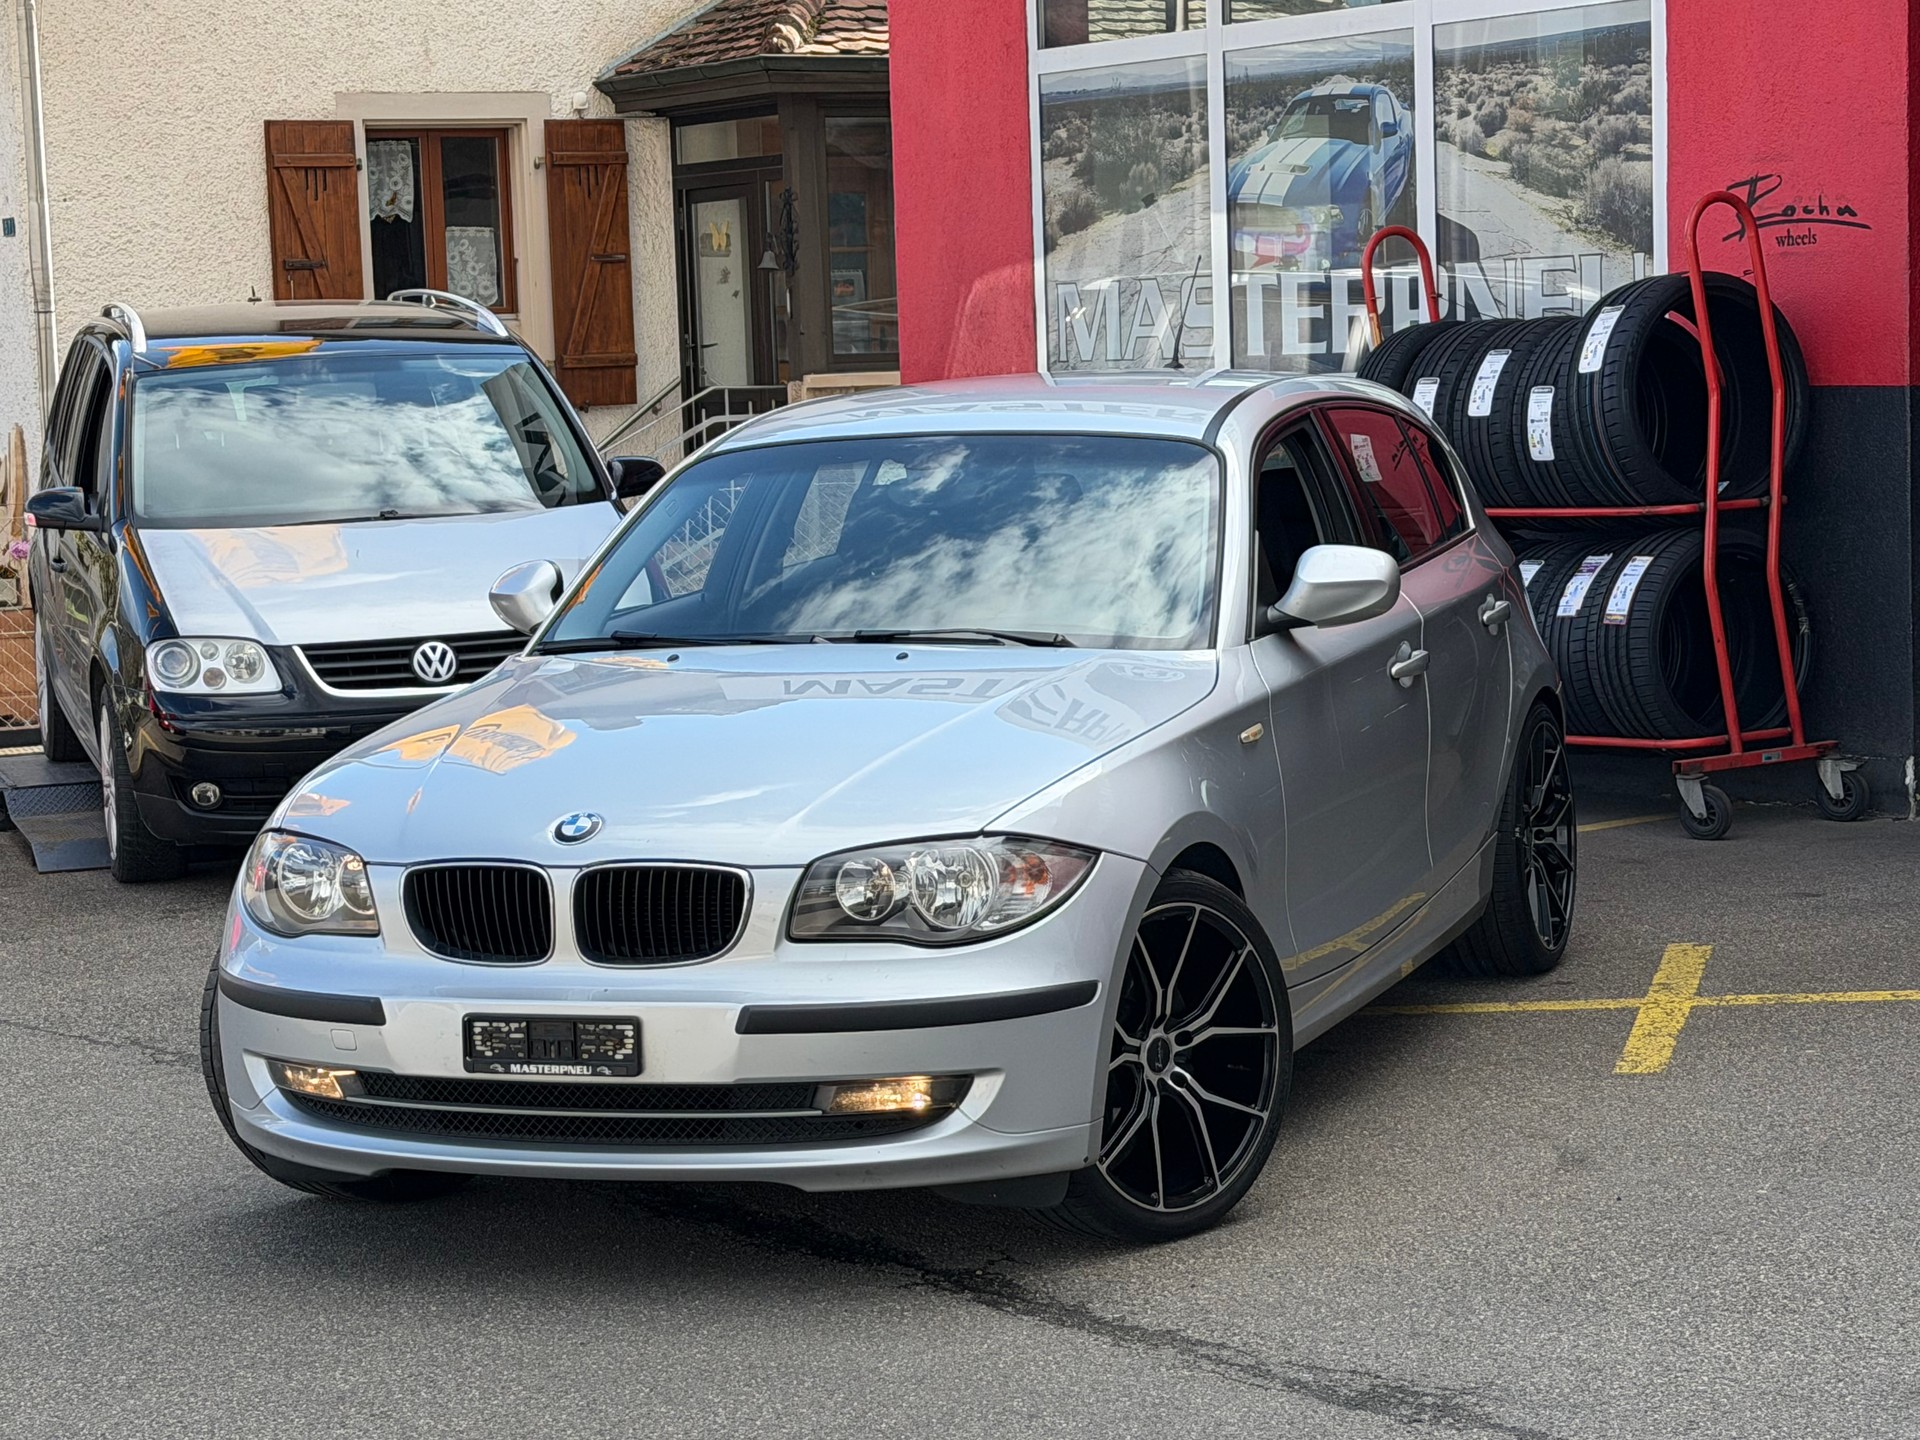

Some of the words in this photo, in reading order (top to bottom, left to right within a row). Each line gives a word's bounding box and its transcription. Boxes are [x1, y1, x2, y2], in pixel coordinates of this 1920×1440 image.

[1722, 172, 1872, 242] Rocha
[1775, 227, 1818, 248] wheels
[413, 641, 456, 682] VW
[510, 1063, 592, 1075] MASTERPNEU
